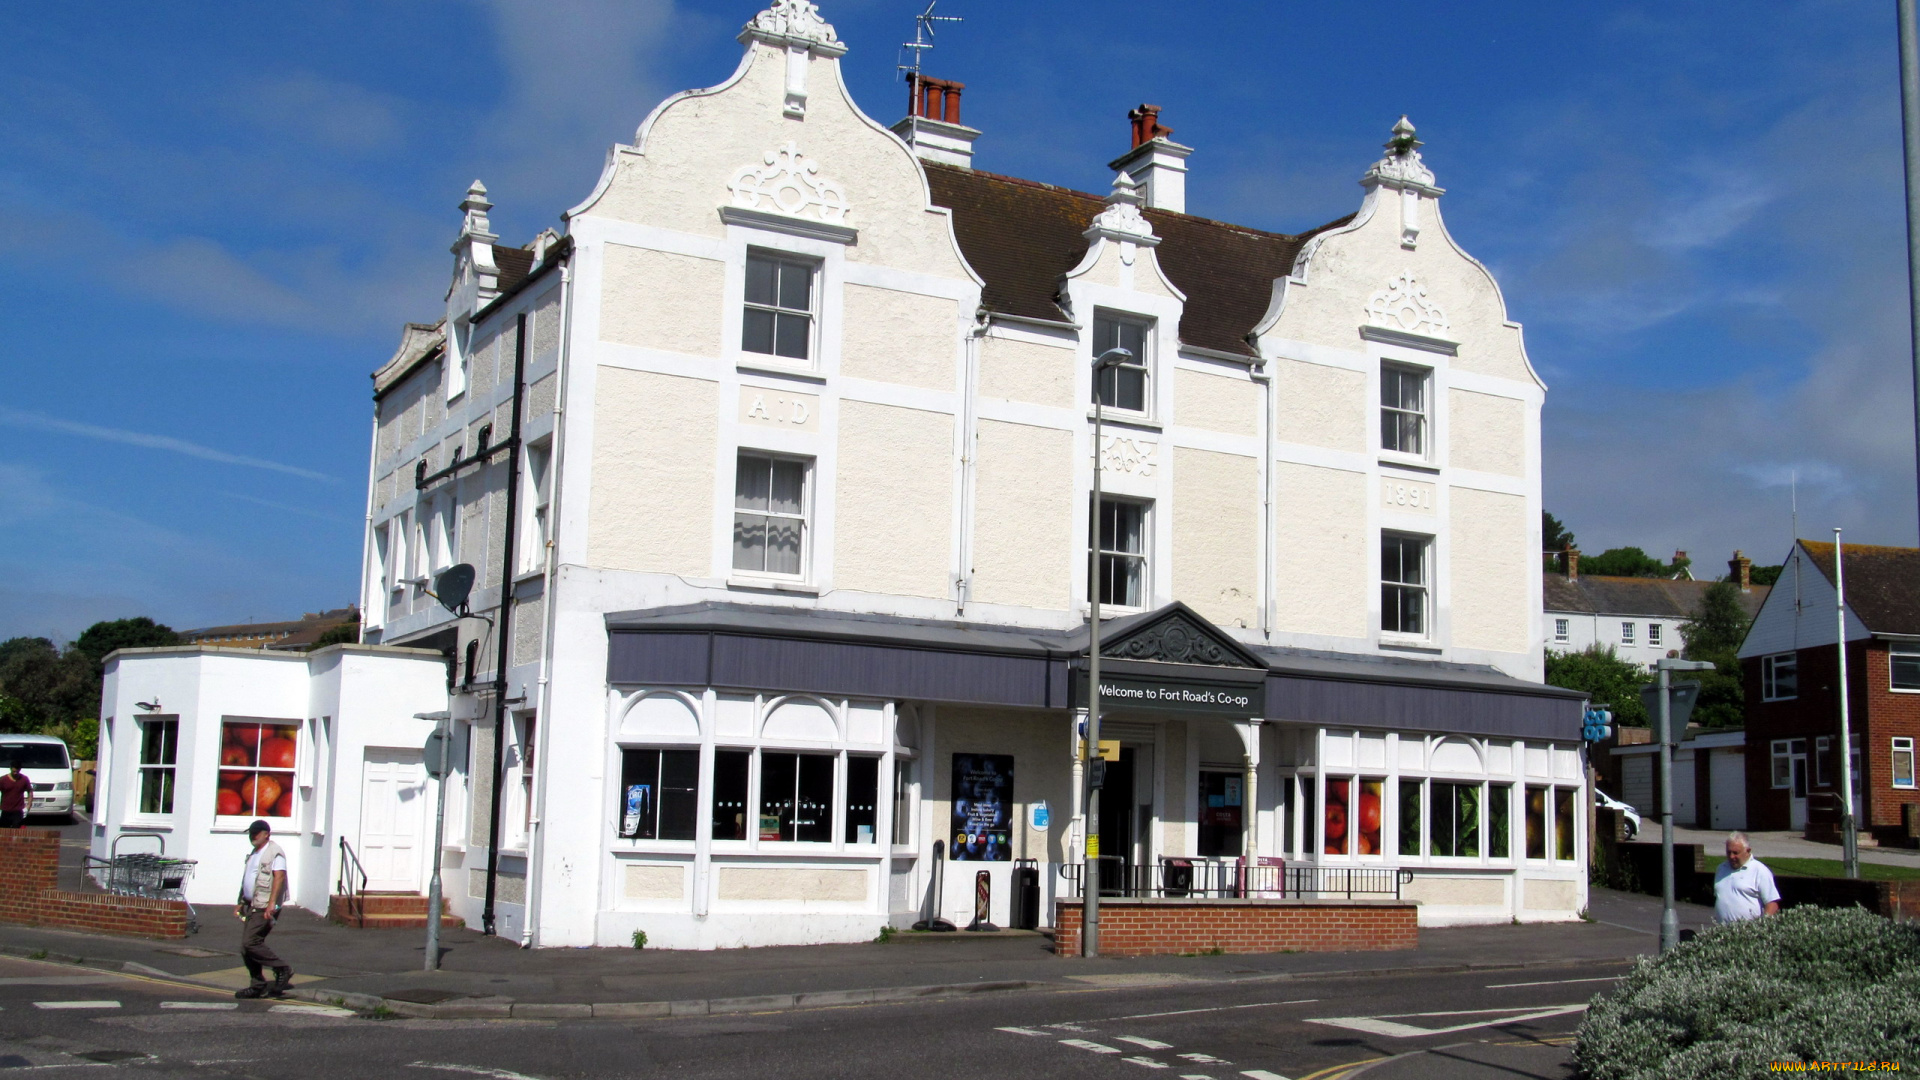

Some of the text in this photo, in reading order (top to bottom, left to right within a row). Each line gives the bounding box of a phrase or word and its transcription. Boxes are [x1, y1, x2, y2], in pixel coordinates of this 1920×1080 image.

[1386, 483, 1430, 509] 1891
[1098, 684, 1249, 708] Welcome to Fort Road's Co-op
